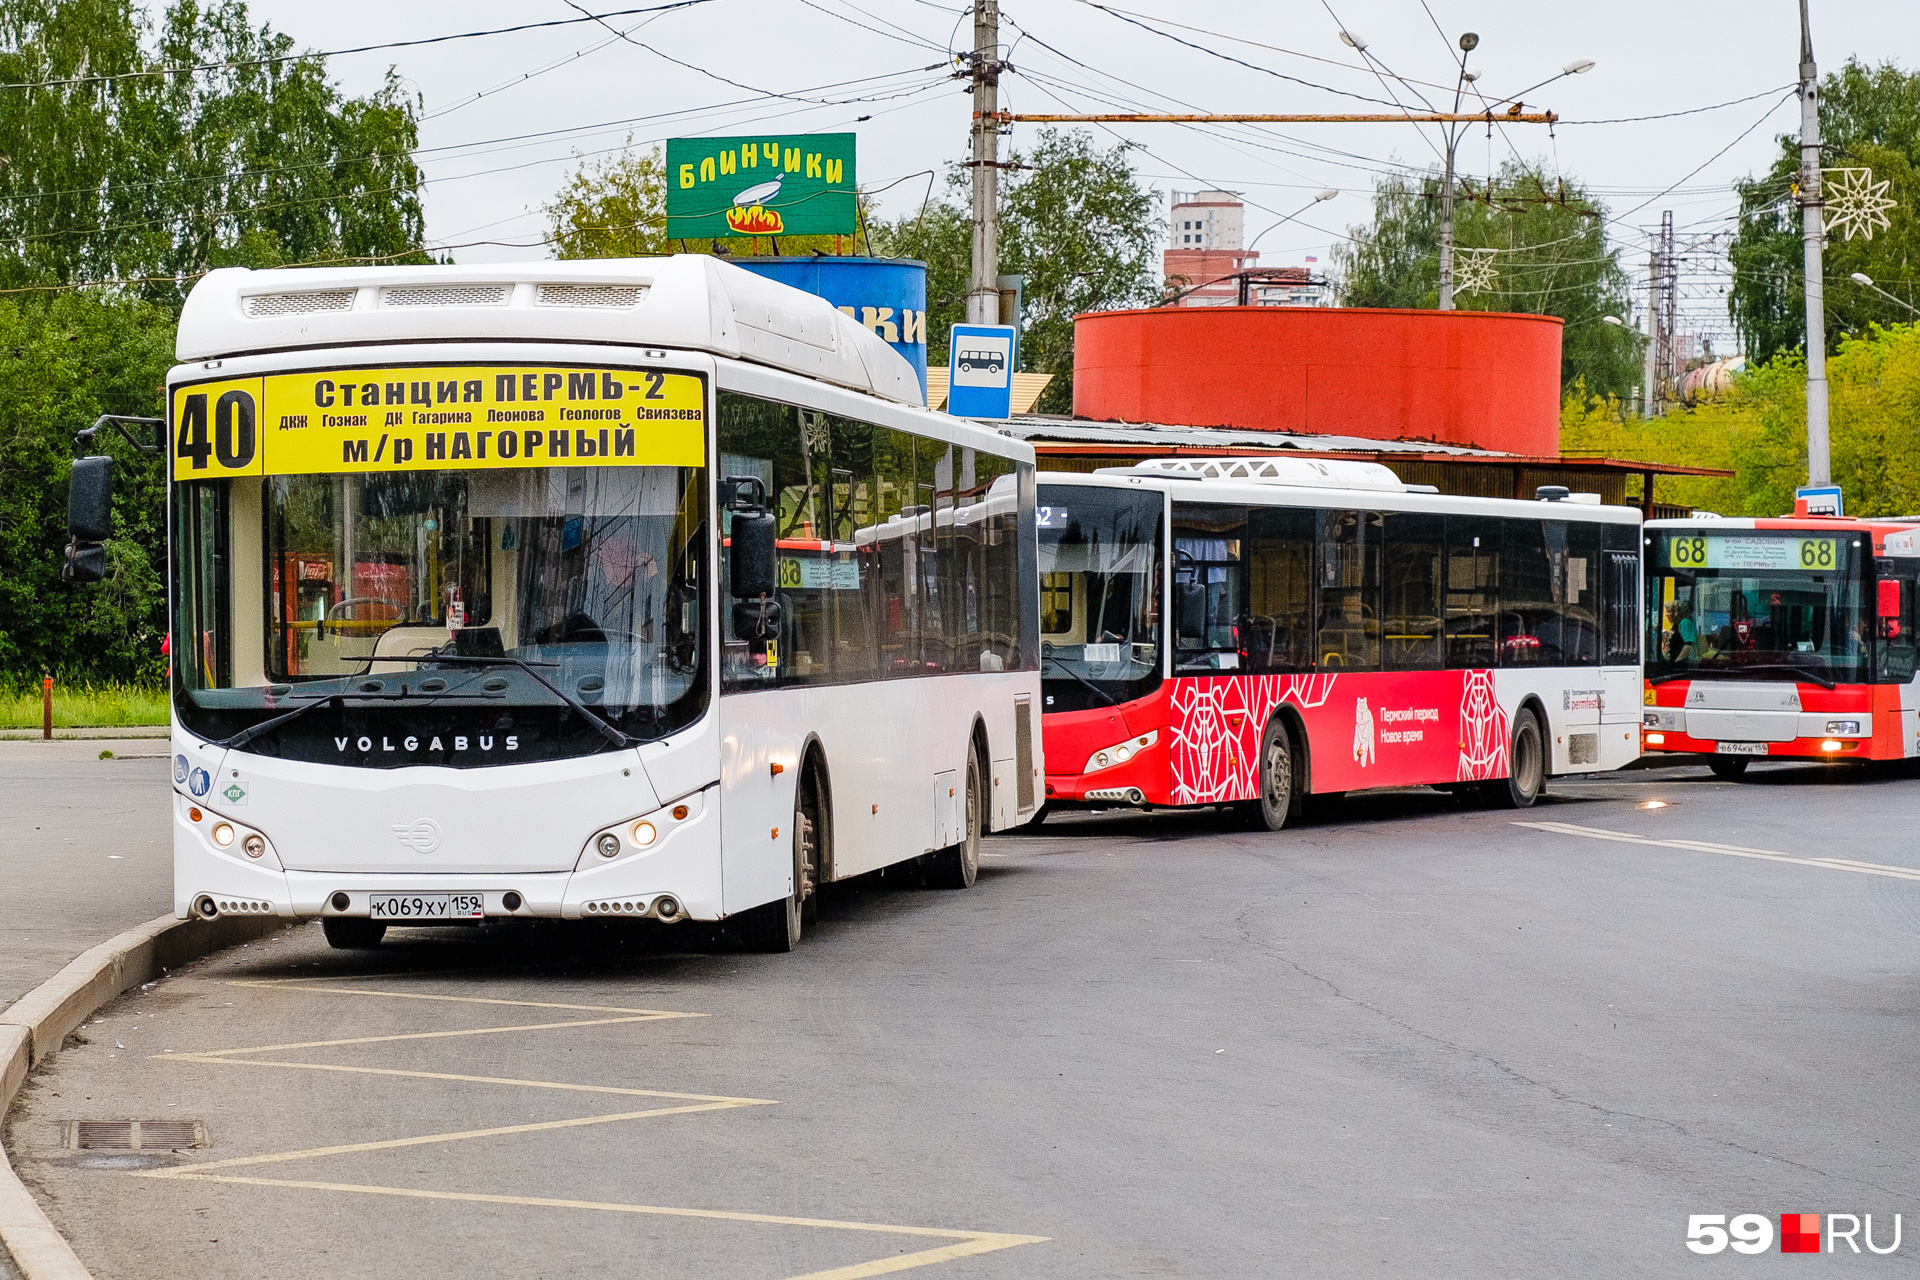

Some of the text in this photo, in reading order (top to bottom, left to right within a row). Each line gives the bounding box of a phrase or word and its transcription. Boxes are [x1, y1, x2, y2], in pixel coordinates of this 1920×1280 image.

[679, 143, 843, 188] БЛИНЧИКИ
[837, 306, 926, 344] КИ
[314, 372, 665, 408] Станция ПЕРМЬ-2
[177, 389, 256, 470] 40
[279, 406, 702, 431] ДКЖ Гознак ДК Гагарина Леонова Геологов Свиязева
[342, 423, 635, 464] м/р НАГОРНЫЙ
[1675, 537, 1706, 563] 68
[1801, 540, 1832, 566] 68
[1380, 707, 1439, 725] Пермский период
[334, 736, 519, 752] VOLGABUS
[1380, 729, 1424, 746] Новое время
[227, 789, 242, 798] КПГ
[451, 896, 479, 911] 159
